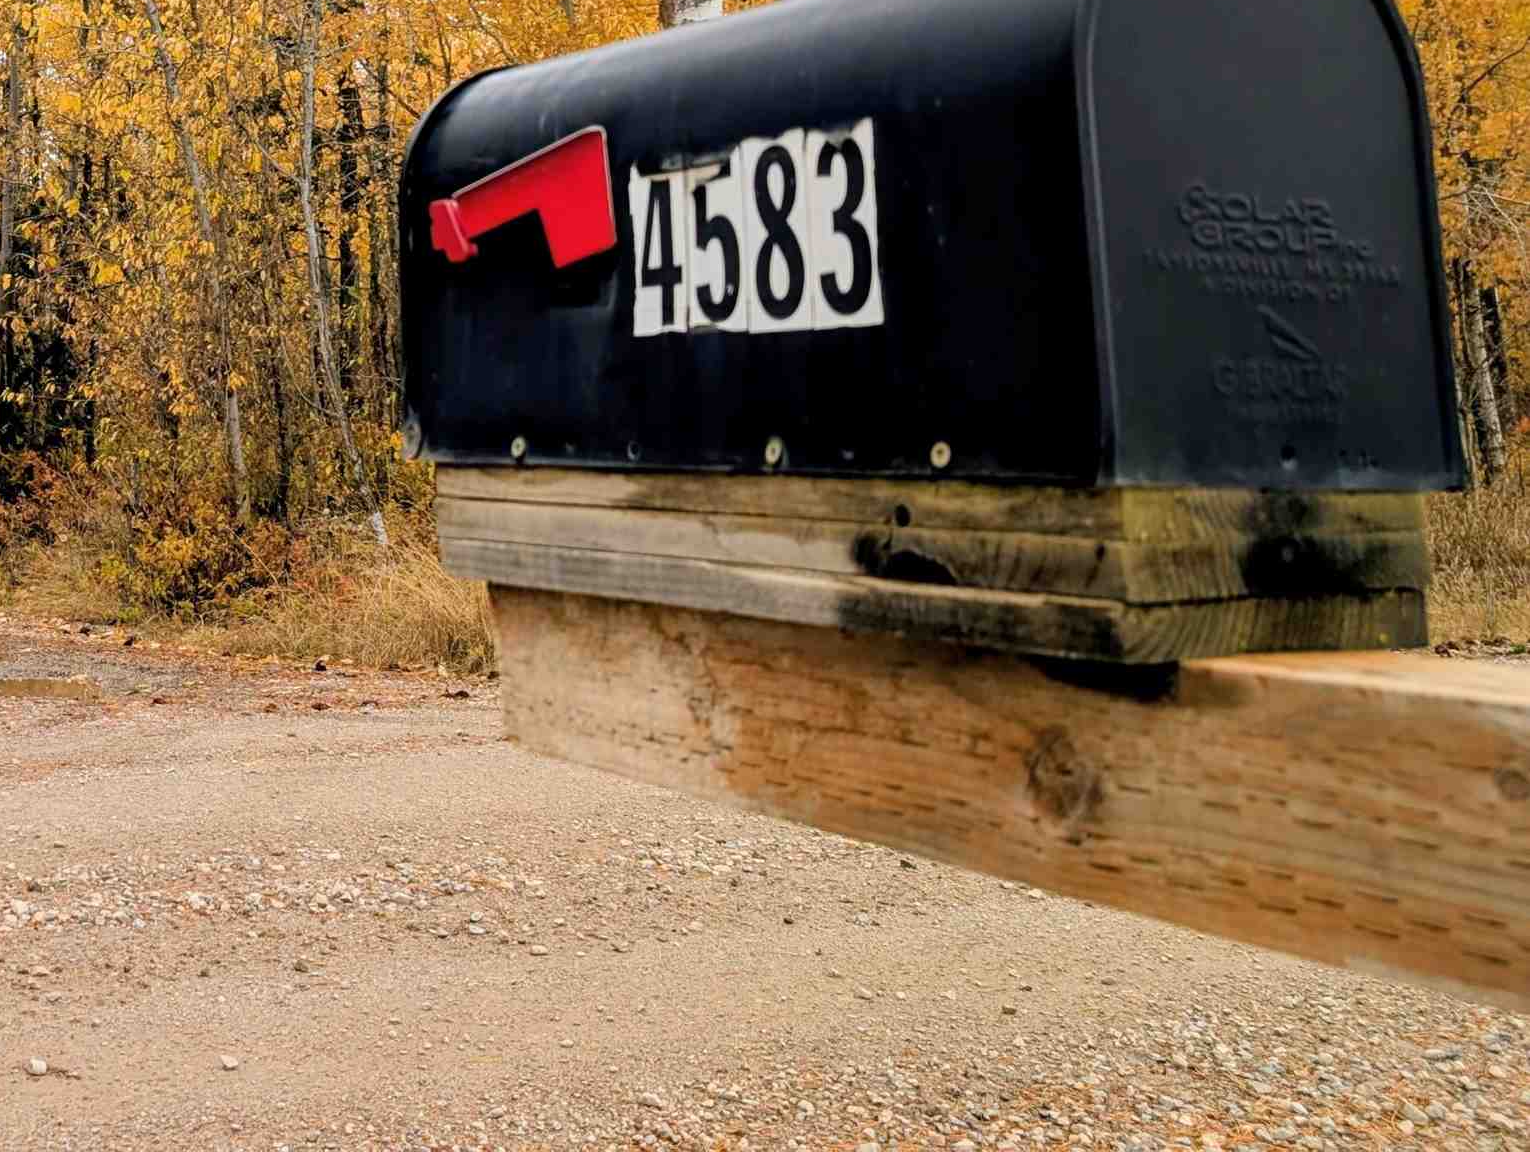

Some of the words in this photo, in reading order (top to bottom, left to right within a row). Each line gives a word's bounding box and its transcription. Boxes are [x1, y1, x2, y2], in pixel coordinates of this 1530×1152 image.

[1177, 182, 1336, 226] SOLAR
[641, 138, 872, 328] 4583
[1190, 220, 1339, 254] GROUP
